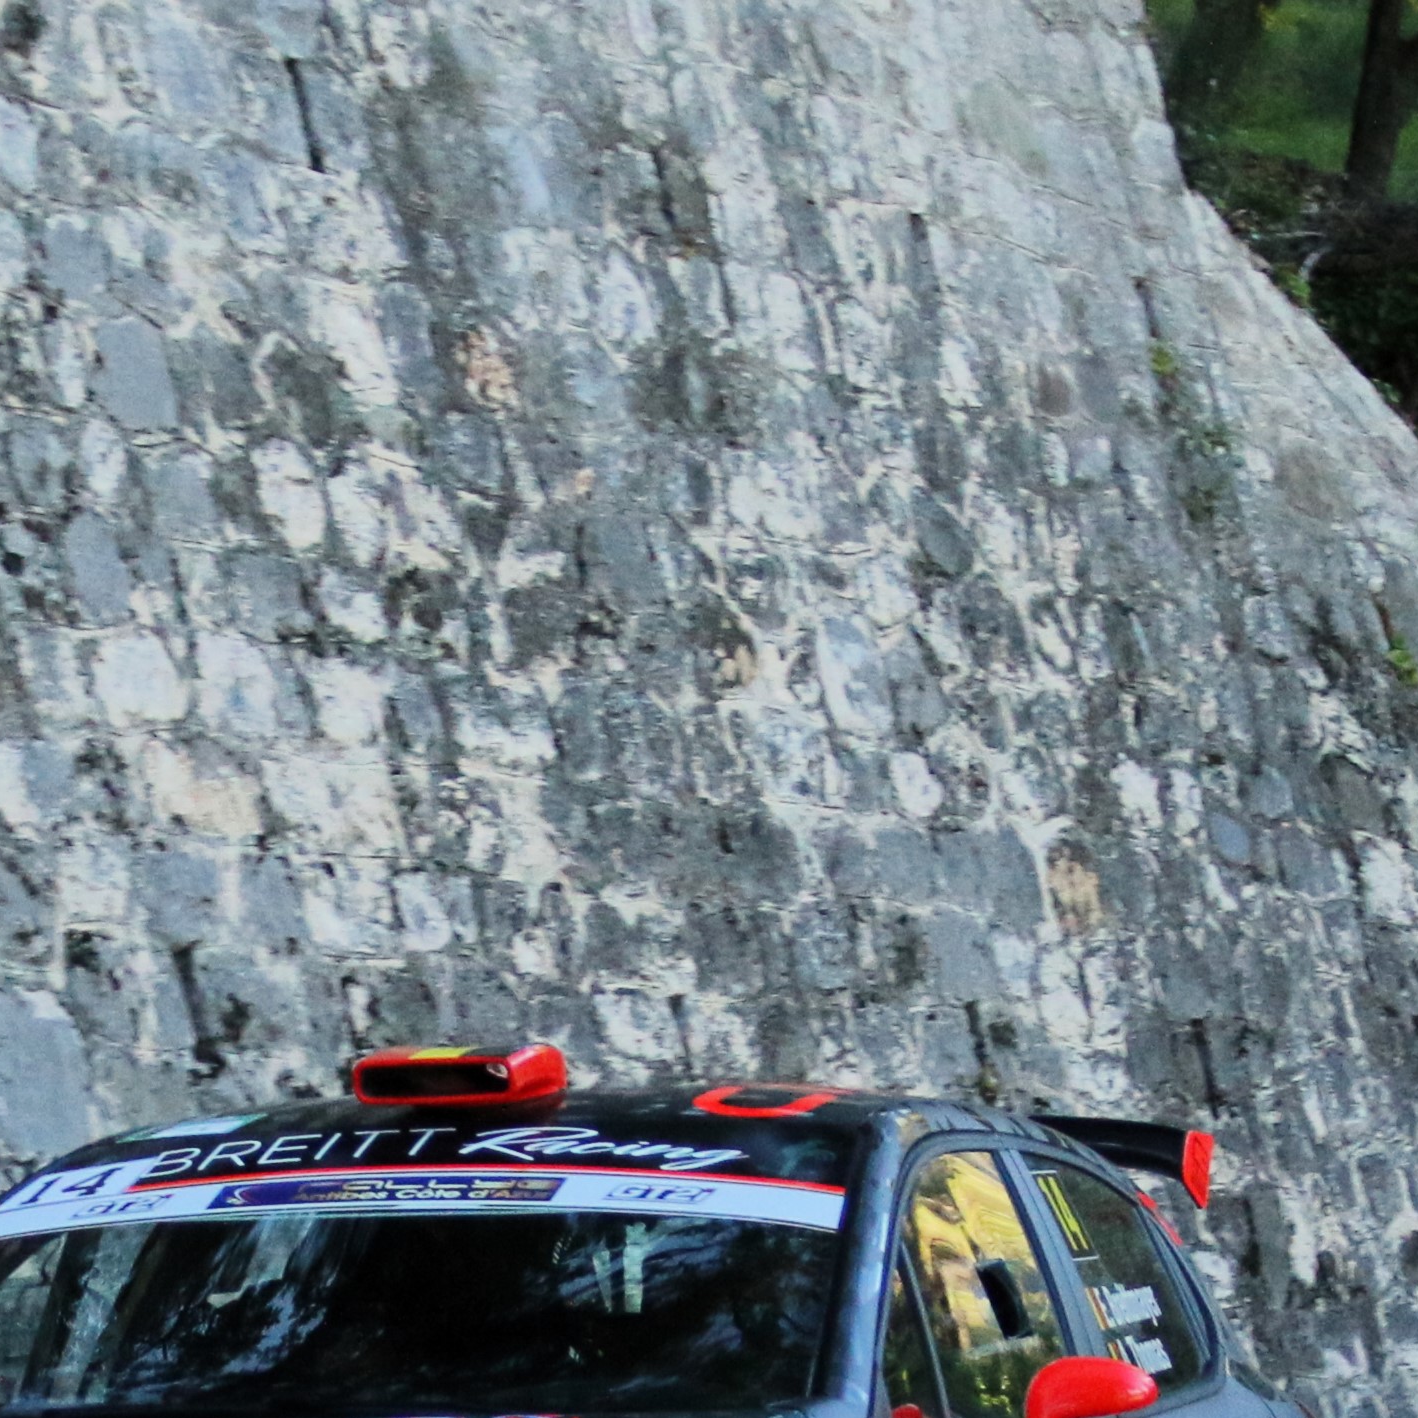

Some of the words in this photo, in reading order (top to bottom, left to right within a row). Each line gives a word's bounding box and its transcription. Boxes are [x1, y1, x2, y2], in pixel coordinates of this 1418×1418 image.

[139, 1128, 456, 1178] BREITT
[458, 1126, 750, 1171] Racing
[21, 1167, 124, 1205] 14
[1036, 1176, 1089, 1251] 14
